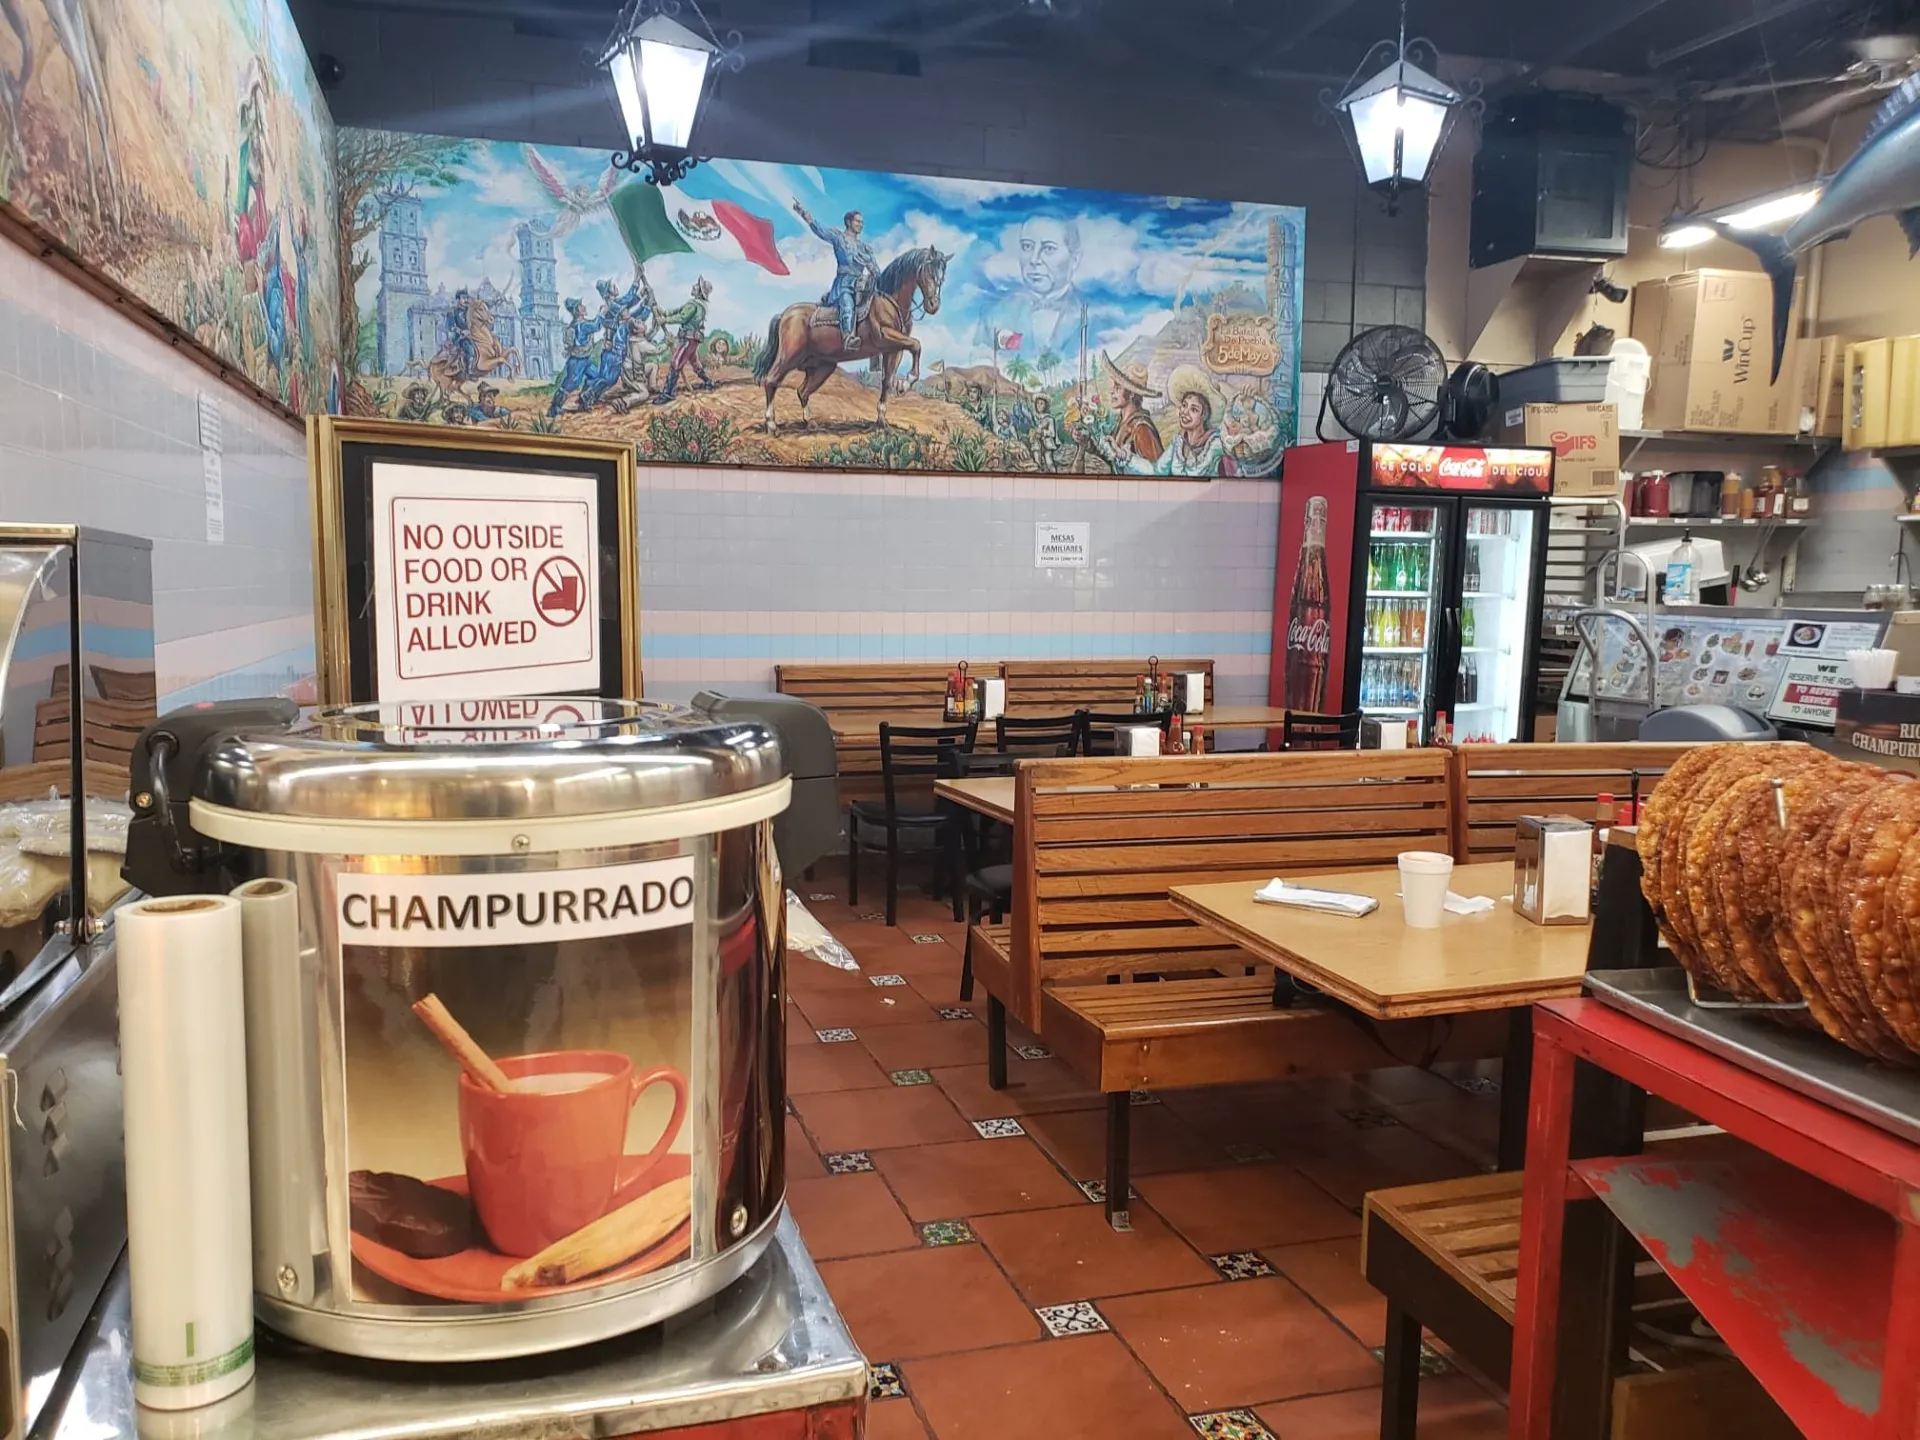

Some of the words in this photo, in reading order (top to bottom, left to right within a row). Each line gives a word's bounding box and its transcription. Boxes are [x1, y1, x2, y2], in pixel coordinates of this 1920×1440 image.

[1733, 318, 1756, 384] WinCup
[1375, 461, 1395, 471] ICE
[1400, 461, 1433, 473] COLD
[1492, 465, 1549, 477] DELICIOUS
[403, 524, 444, 550] NO
[452, 524, 564, 550] OUTSIDE
[1051, 534, 1075, 542] MESAS
[1042, 545, 1083, 553] FAMILIARES
[404, 558, 483, 584] FOOD
[491, 557, 528, 582] OR
[406, 590, 492, 618] DRINK
[407, 620, 538, 653] ALLOWED
[1287, 616, 1330, 654] Coca-Cola
[1817, 664, 1839, 673] WE
[1822, 675, 1837, 684] THE
[1803, 707, 1832, 717] ANYONE
[342, 875, 695, 932] CHAMPURRADO
